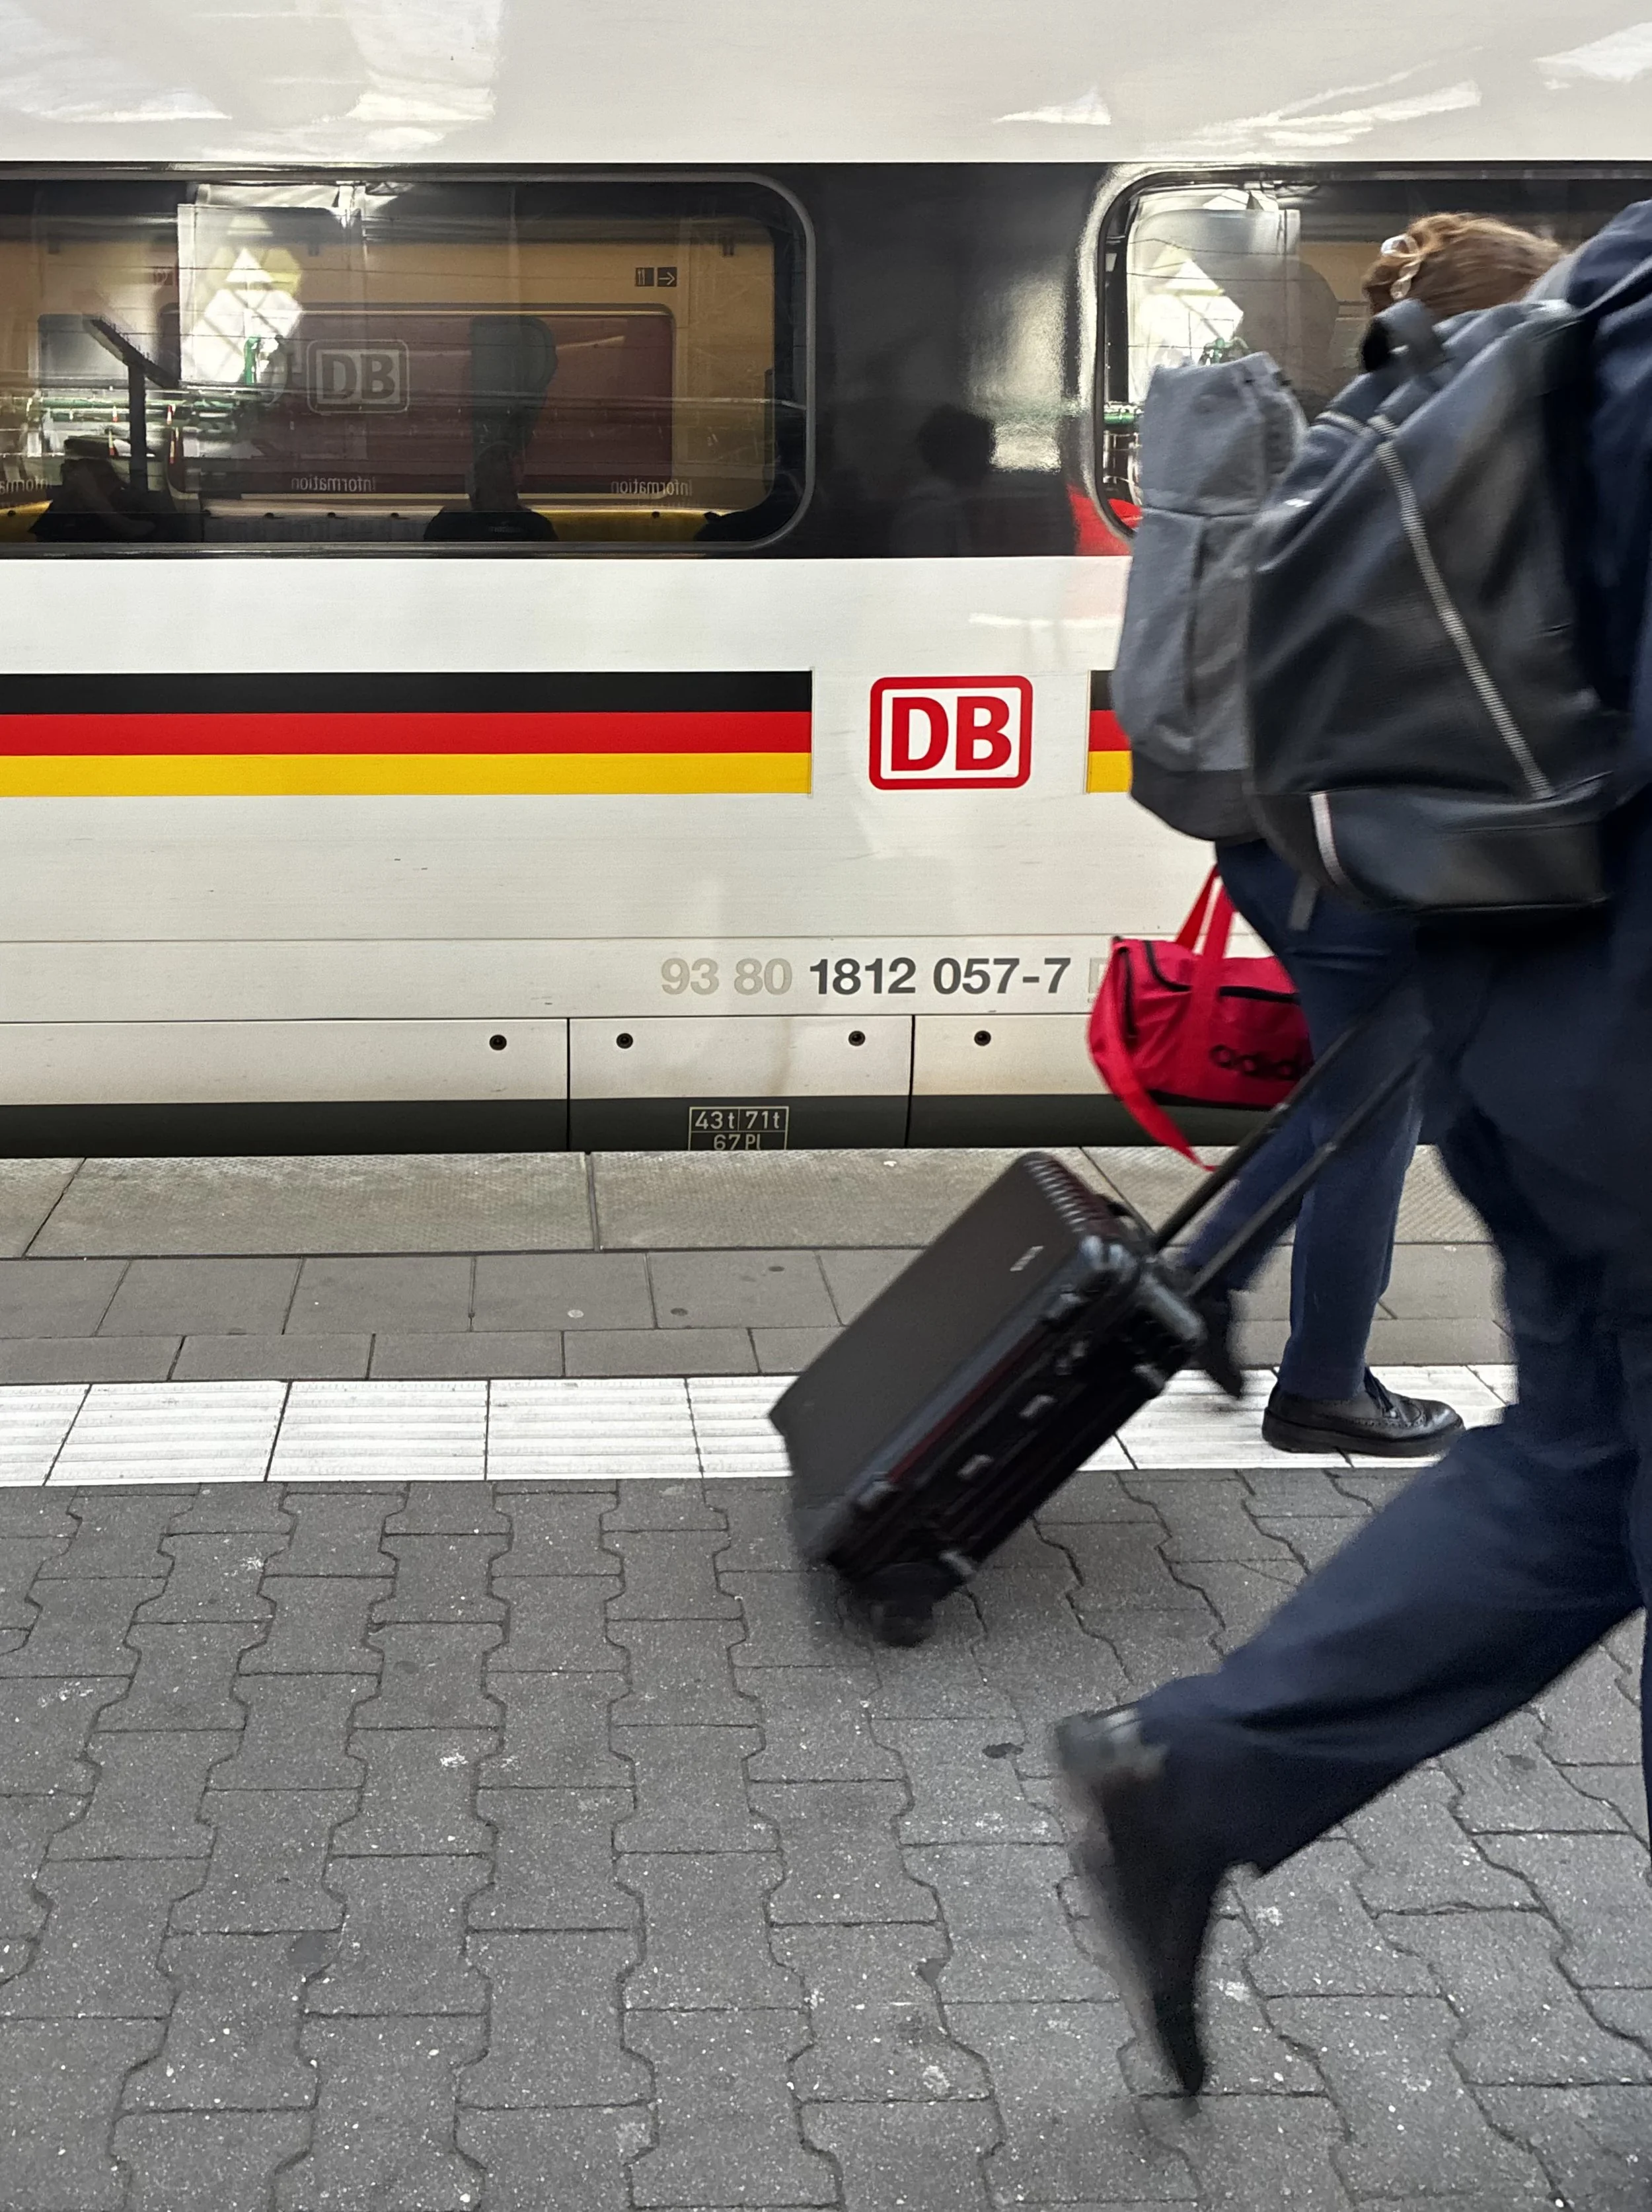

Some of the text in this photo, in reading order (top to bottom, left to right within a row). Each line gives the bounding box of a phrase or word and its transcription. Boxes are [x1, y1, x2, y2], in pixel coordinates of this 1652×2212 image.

[322, 354, 395, 400] DB
[891, 696, 1012, 771] DB
[661, 958, 719, 995] 93
[733, 958, 793, 995] 80
[809, 958, 916, 995] 1812
[933, 958, 1071, 994] 057-7
